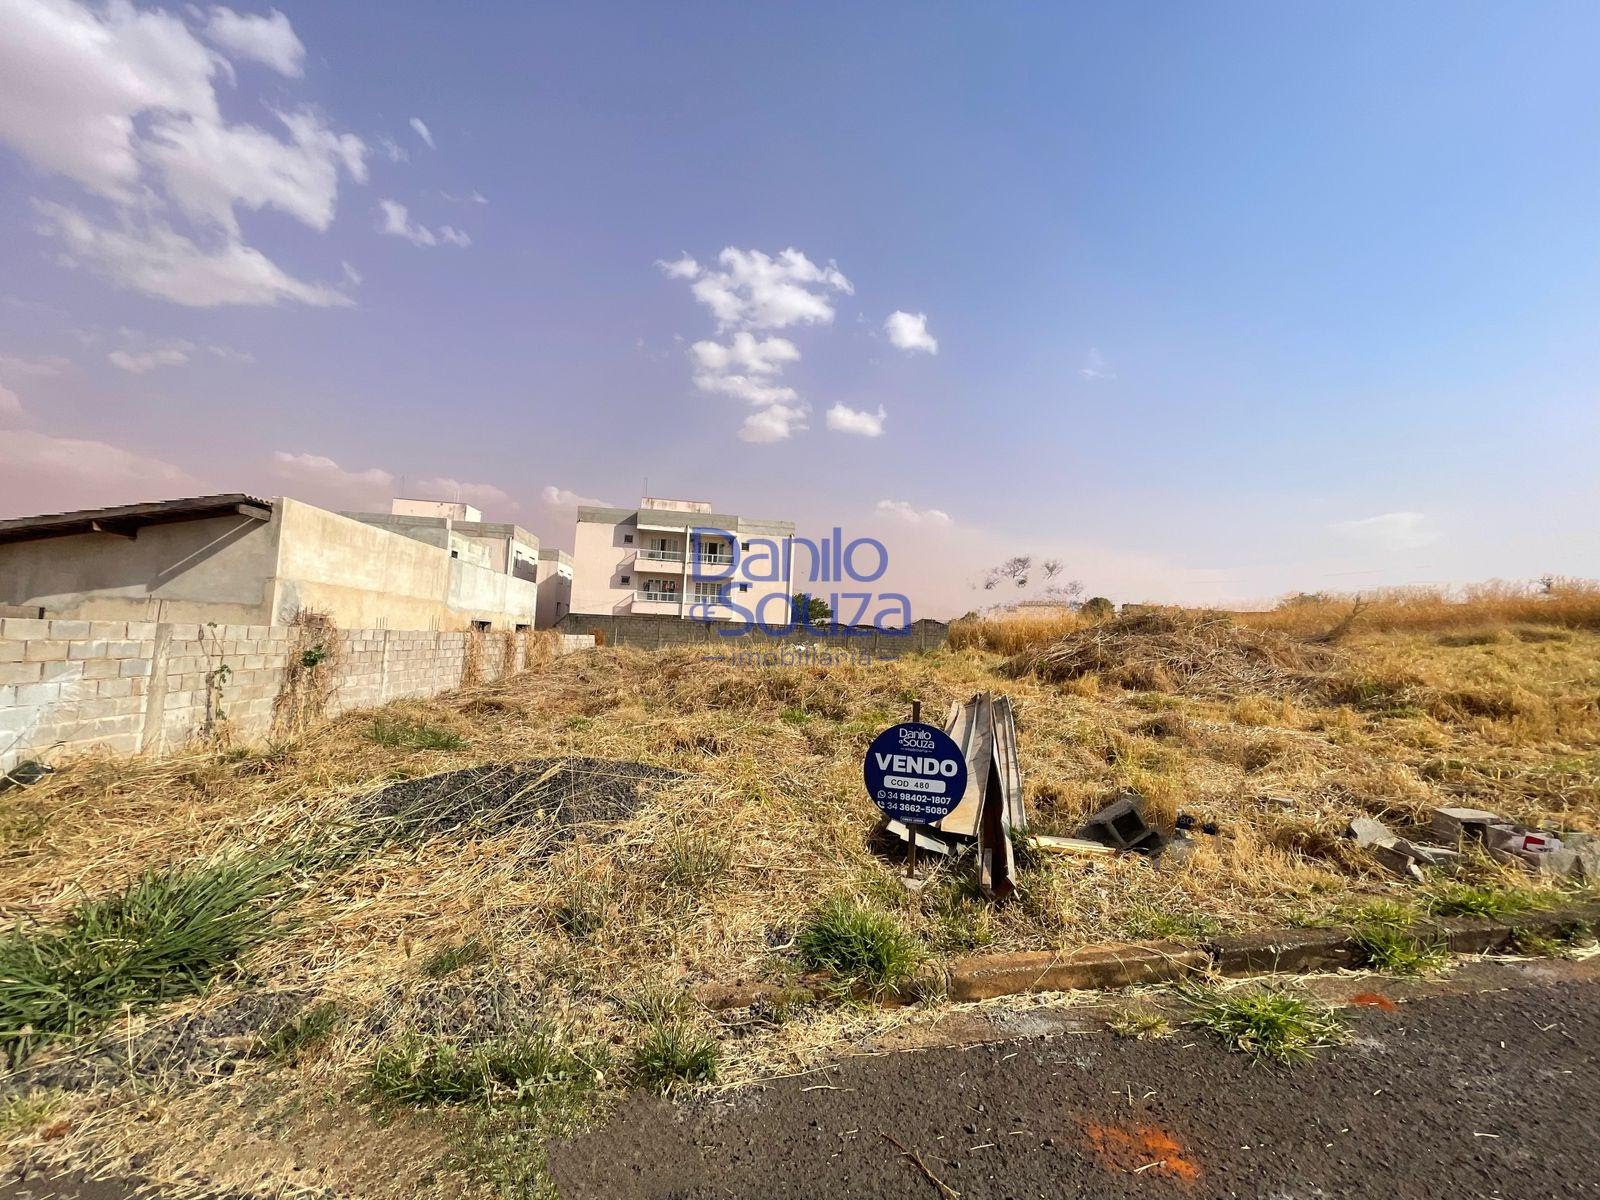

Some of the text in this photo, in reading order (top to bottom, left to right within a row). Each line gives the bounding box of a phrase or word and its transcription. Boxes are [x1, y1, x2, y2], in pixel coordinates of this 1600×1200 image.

[899, 728, 932, 740] Danilo
[875, 752, 958, 777] VENDO
[890, 779, 930, 790] COD 480
[887, 791, 952, 805] 34 98402-1807
[886, 801, 948, 815] 34 3662-5080
